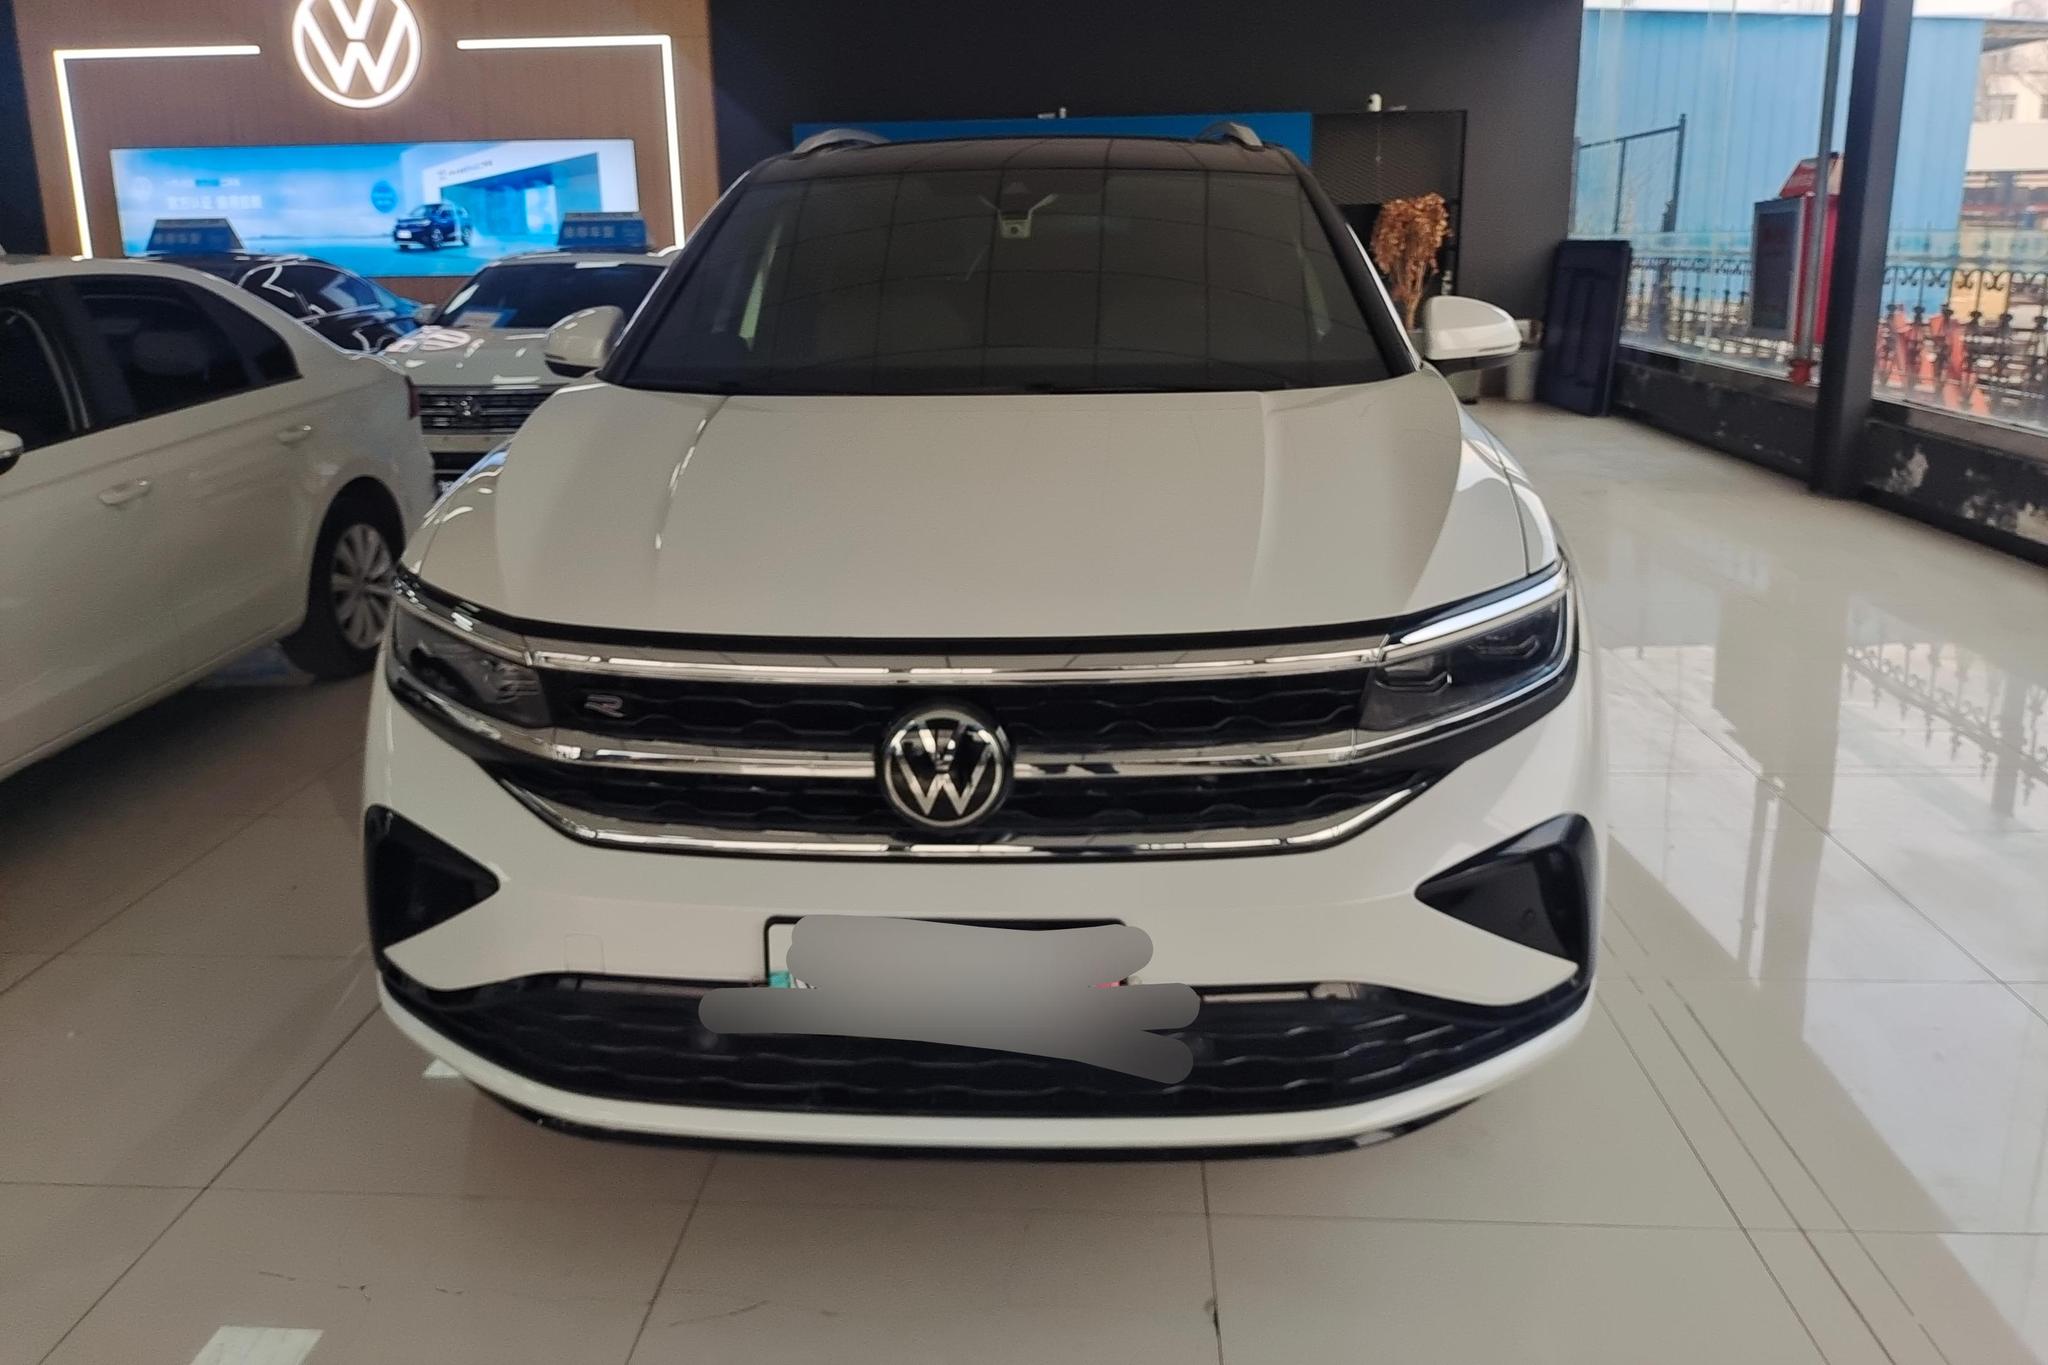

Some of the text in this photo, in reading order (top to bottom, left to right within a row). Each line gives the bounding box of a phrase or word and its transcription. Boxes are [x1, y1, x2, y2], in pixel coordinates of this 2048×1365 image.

[298, 0, 413, 95] VW
[583, 694, 624, 718] R
[888, 717, 1001, 817] VW
